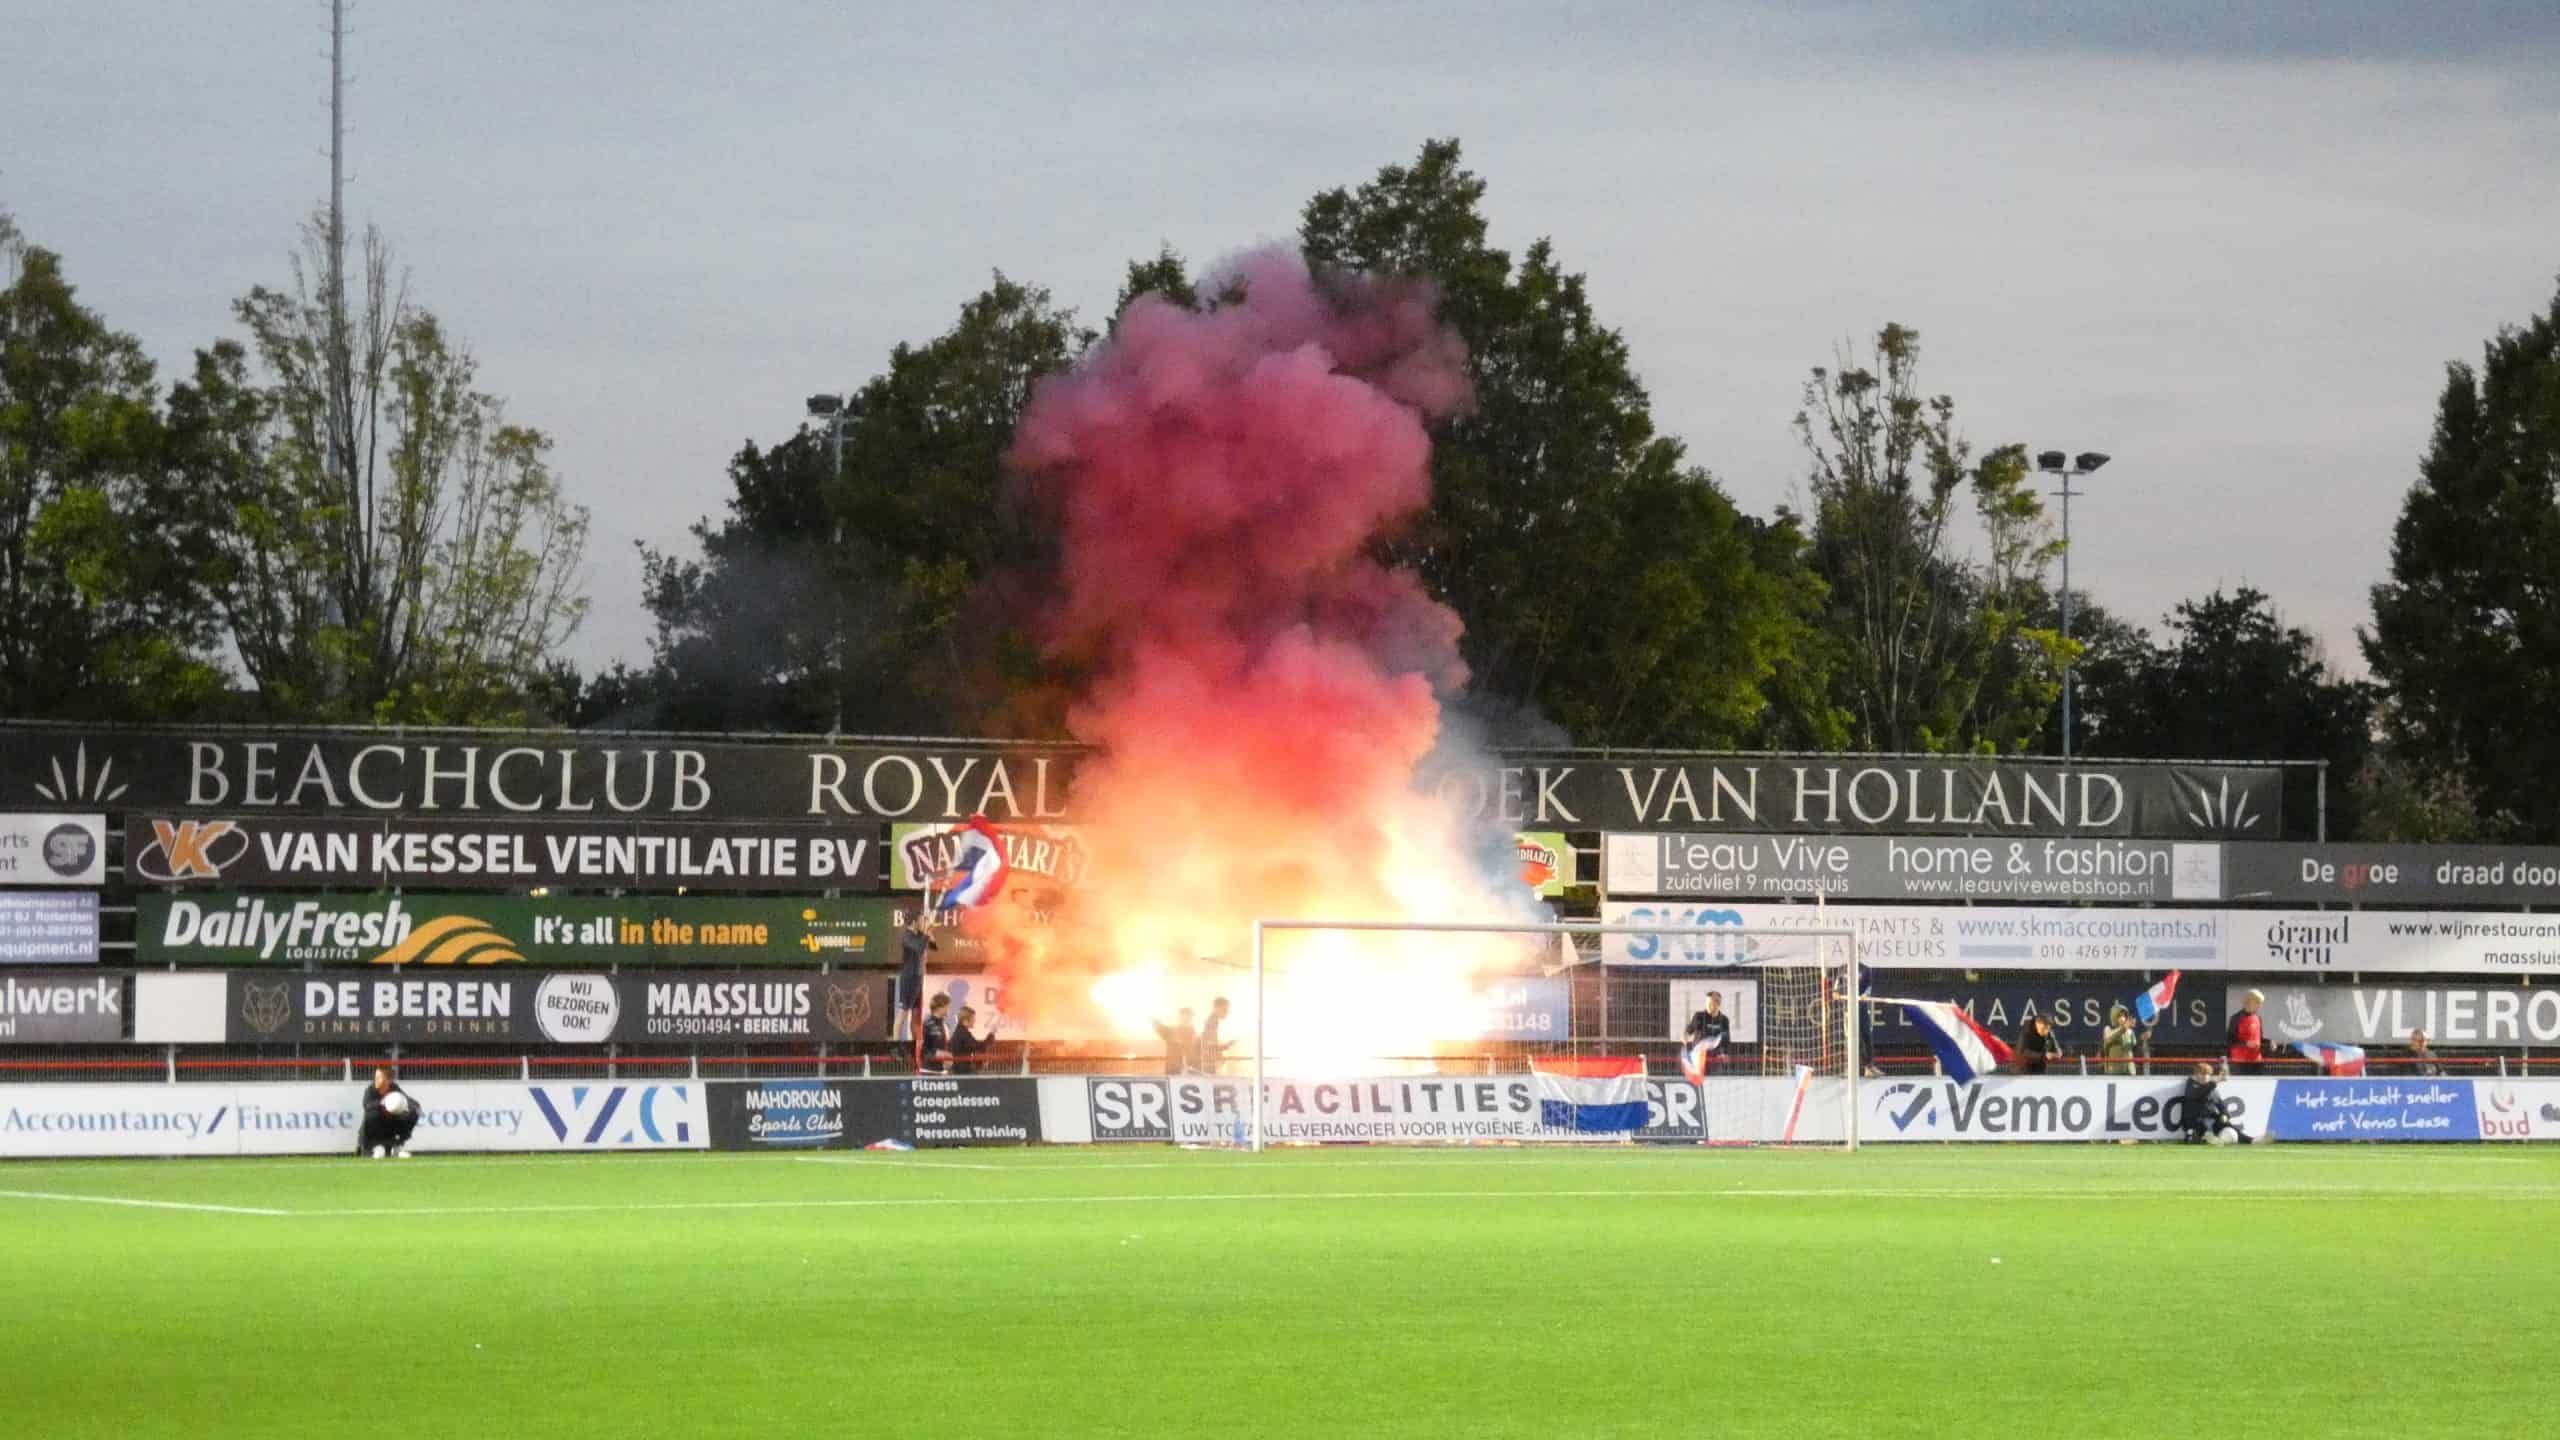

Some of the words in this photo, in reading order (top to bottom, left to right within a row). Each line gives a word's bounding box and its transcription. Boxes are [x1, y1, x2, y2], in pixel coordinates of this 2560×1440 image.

[187, 742, 712, 812] BEACHCLUB
[807, 753, 1066, 818] ROYAL
[1437, 766, 1581, 823] OEK
[1618, 767, 1759, 823] VAN
[1792, 768, 2124, 826] HOLLAND
[260, 833, 357, 872] VAN
[373, 833, 537, 873] KESSEL
[546, 836, 798, 875] VENTILATIE
[809, 838, 867, 877] BV
[1665, 836, 1758, 870] L'eau
[1772, 837, 1849, 872] Vive
[1889, 840, 1993, 873] home
[2006, 843, 2031, 874] &
[2044, 840, 2169, 876] fashion
[2302, 859, 2335, 883] De
[2436, 860, 2505, 885] draad
[1665, 874, 1741, 891] zuidvliet
[1747, 875, 1755, 890] 9
[1763, 876, 1849, 893] maassluis
[1905, 877, 2154, 897] www.leauvivewebshop.nl
[164, 895, 412, 960] DailyFresh
[534, 915, 574, 945] It's
[580, 916, 614, 945] all
[620, 917, 645, 944] in
[653, 917, 694, 945] the
[701, 923, 768, 945] name
[1956, 916, 2217, 938] www.skmaccountants.nl
[2266, 915, 2348, 950] grand
[287, 948, 359, 960] LOGISTICS
[1831, 939, 1946, 957] AVISEURS
[2040, 946, 2065, 958] 010
[569, 981, 592, 995] WIJ
[304, 982, 361, 1017] DE
[373, 982, 511, 1017] BEREN
[547, 995, 609, 1015] BEZORGEN
[648, 983, 810, 1017] MAASSLUIS
[304, 1021, 391, 1033] DINNER
[427, 1021, 510, 1033] DRINKS
[562, 1015, 591, 1029] OOK!
[647, 1019, 731, 1034] 010-5901494
[743, 1018, 810, 1034] BEREN.NL
[912, 1080, 958, 1091] Fitness
[747, 1089, 842, 1109] MAHOROKAN
[913, 1095, 1000, 1109] Groepslessen
[1094, 1082, 1168, 1129] SR
[1179, 1084, 1240, 1115] SR
[1251, 1083, 1532, 1114] ACILITIES
[1945, 1083, 2092, 1133] Vemo
[2296, 1088, 2328, 1108] Het
[2333, 1087, 2402, 1106] schakelt
[2406, 1086, 2459, 1104] sneller
[237, 1106, 353, 1131] Finance
[418, 1109, 523, 1136] ecovery
[750, 1114, 801, 1136] Sports
[806, 1113, 844, 1131] Club
[914, 1112, 945, 1124] Judo
[2312, 1114, 2346, 1132] met
[2350, 1112, 2397, 1130] Vemo
[2401, 1110, 2451, 1128] Lease
[2481, 1111, 2531, 1136] bud
[916, 1127, 970, 1140] Personal
[973, 1126, 1027, 1139] Training
[1182, 1123, 1208, 1137] UW
[1400, 1122, 1446, 1136] VOOR
